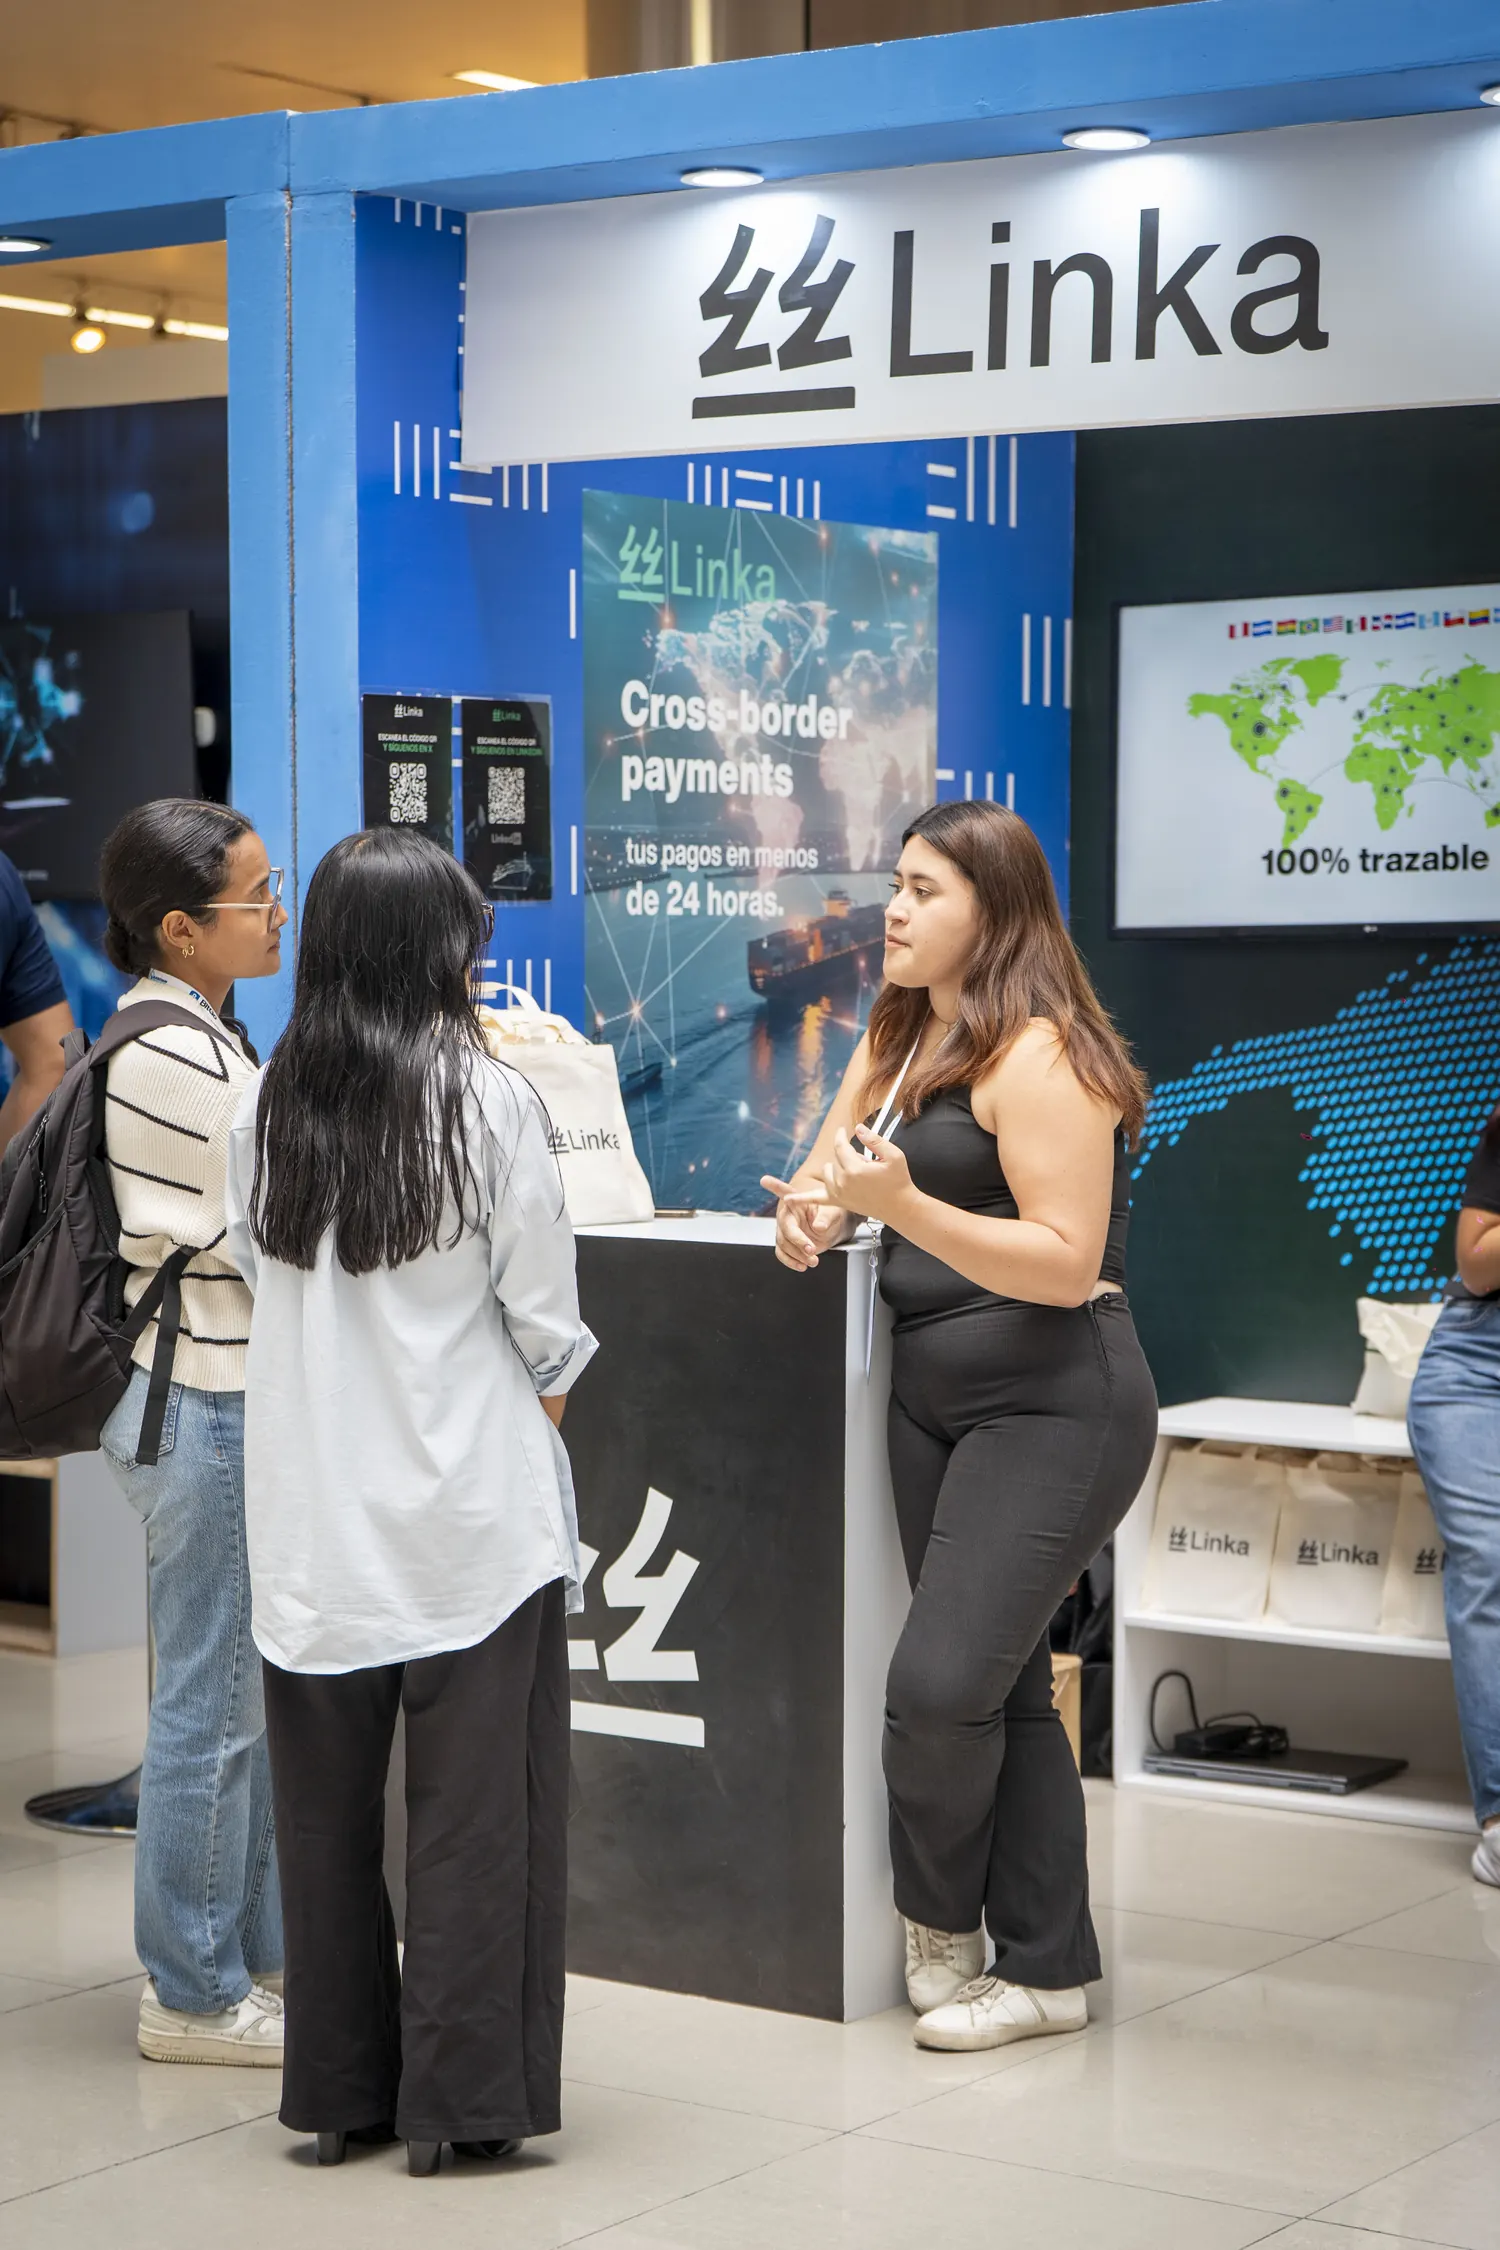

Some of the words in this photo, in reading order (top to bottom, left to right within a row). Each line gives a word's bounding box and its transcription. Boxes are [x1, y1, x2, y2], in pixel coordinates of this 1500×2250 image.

[889, 207, 1330, 378] Linka
[670, 540, 777, 602] Linka
[404, 705, 423, 718] Linka
[502, 709, 522, 721] Linka
[620, 679, 853, 740] Cross-border
[621, 753, 794, 803] payments
[625, 837, 658, 866] tus
[661, 843, 721, 873] pagos
[726, 845, 751, 868] en
[755, 845, 819, 869] menos
[1261, 847, 1350, 875] 100%
[1359, 844, 1490, 873] trazable
[626, 880, 660, 917] de
[666, 880, 701, 917] 24
[706, 881, 785, 918] horas.
[1190, 1530, 1251, 1557] Linka
[1320, 1541, 1380, 1567] Linka
